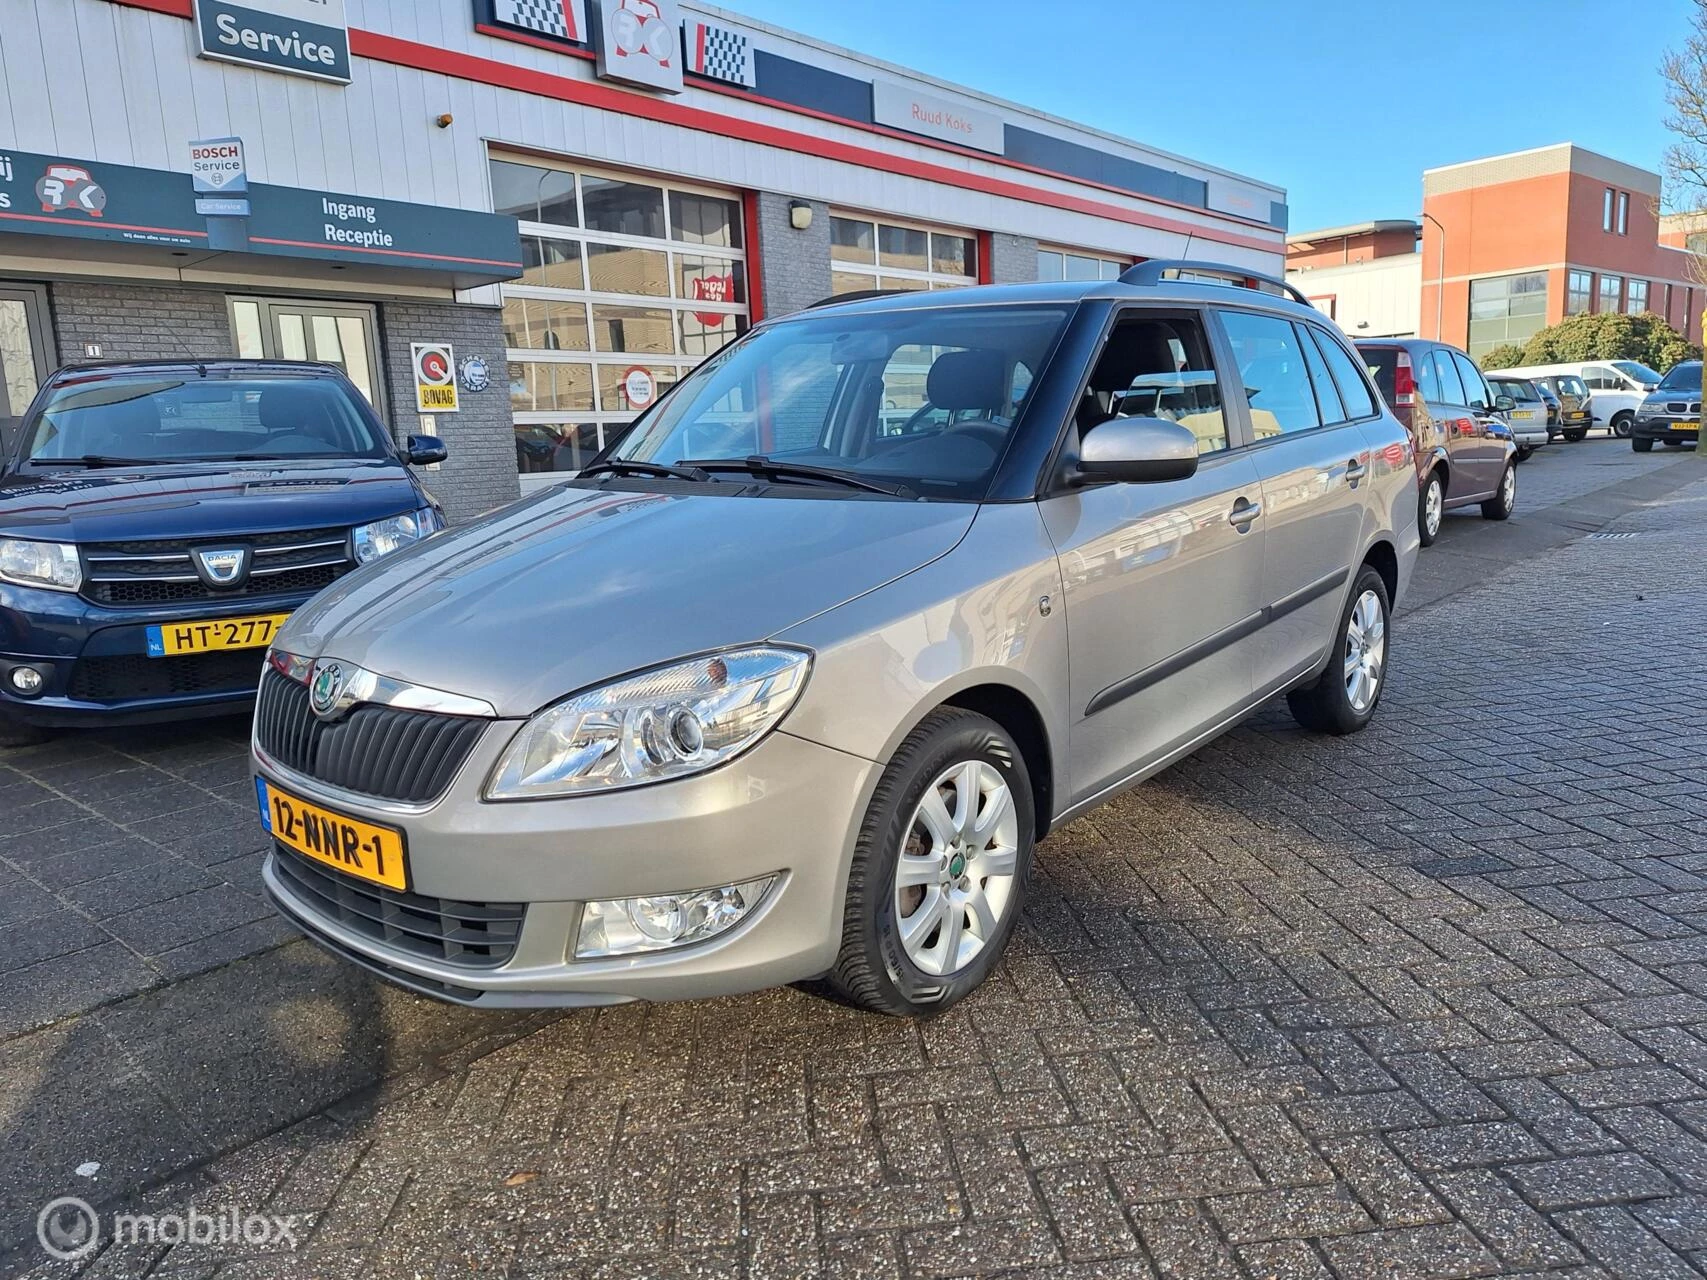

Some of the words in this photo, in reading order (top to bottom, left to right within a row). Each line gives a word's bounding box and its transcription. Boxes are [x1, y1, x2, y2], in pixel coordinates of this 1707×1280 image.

[216, 13, 335, 66] Service
[911, 104, 942, 125] Ruud
[944, 114, 973, 134] Koks
[192, 146, 238, 160] BOSCH
[194, 160, 240, 171] Service
[215, 202, 241, 210] Service
[322, 198, 376, 223] Ingang
[324, 224, 393, 248] Receptie
[423, 389, 453, 405] BOVAG
[150, 643, 163, 651] NL
[273, 796, 385, 876] 12-NNR-1
